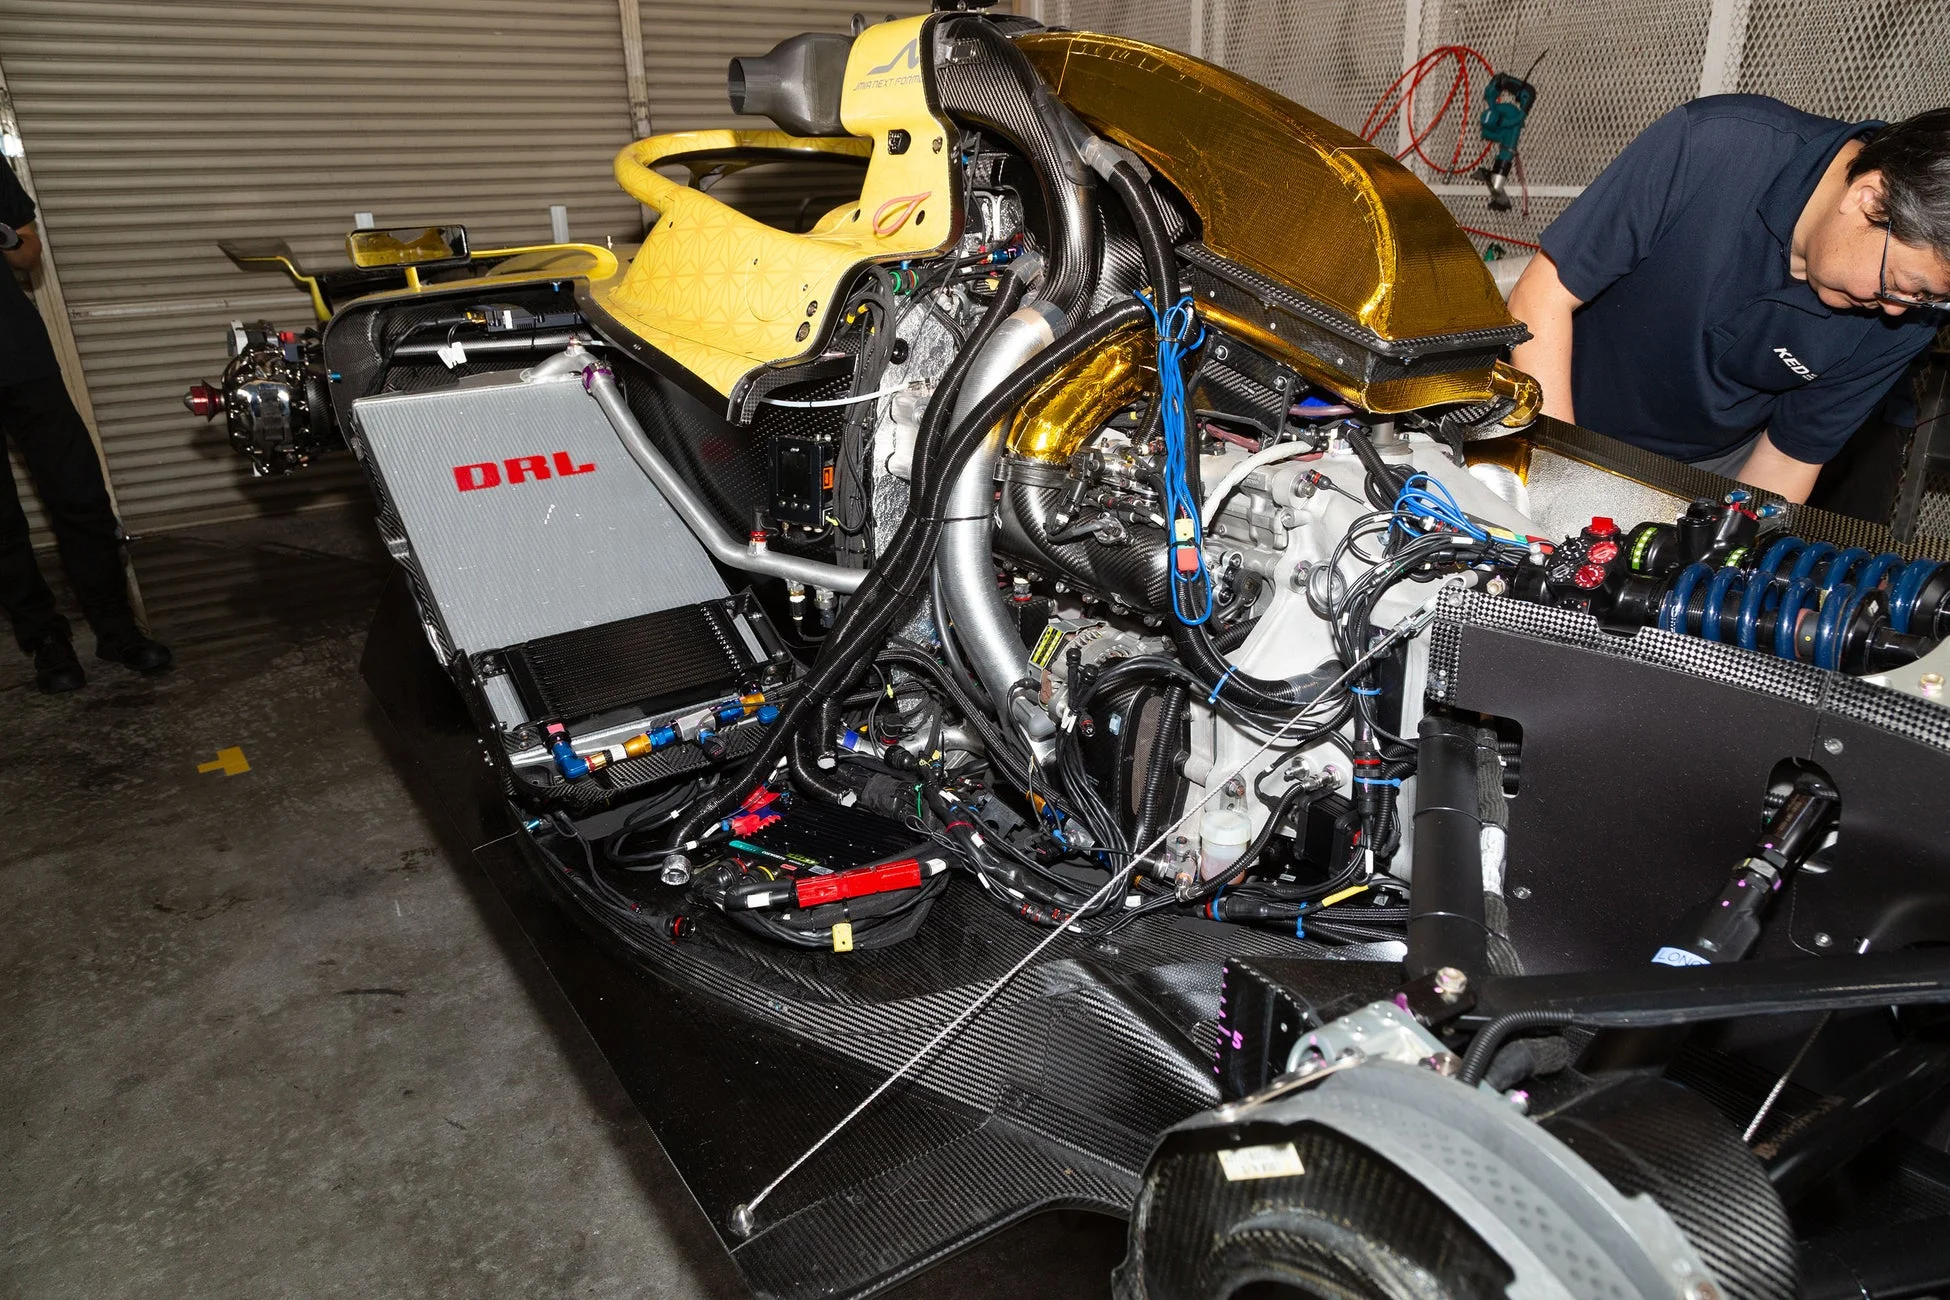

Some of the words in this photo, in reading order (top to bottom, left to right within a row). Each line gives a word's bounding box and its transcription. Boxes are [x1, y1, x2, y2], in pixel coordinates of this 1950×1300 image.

[872, 78, 894, 89] NEXT
[452, 450, 597, 493] DRL
[1231, 1029, 1244, 1050] 5
